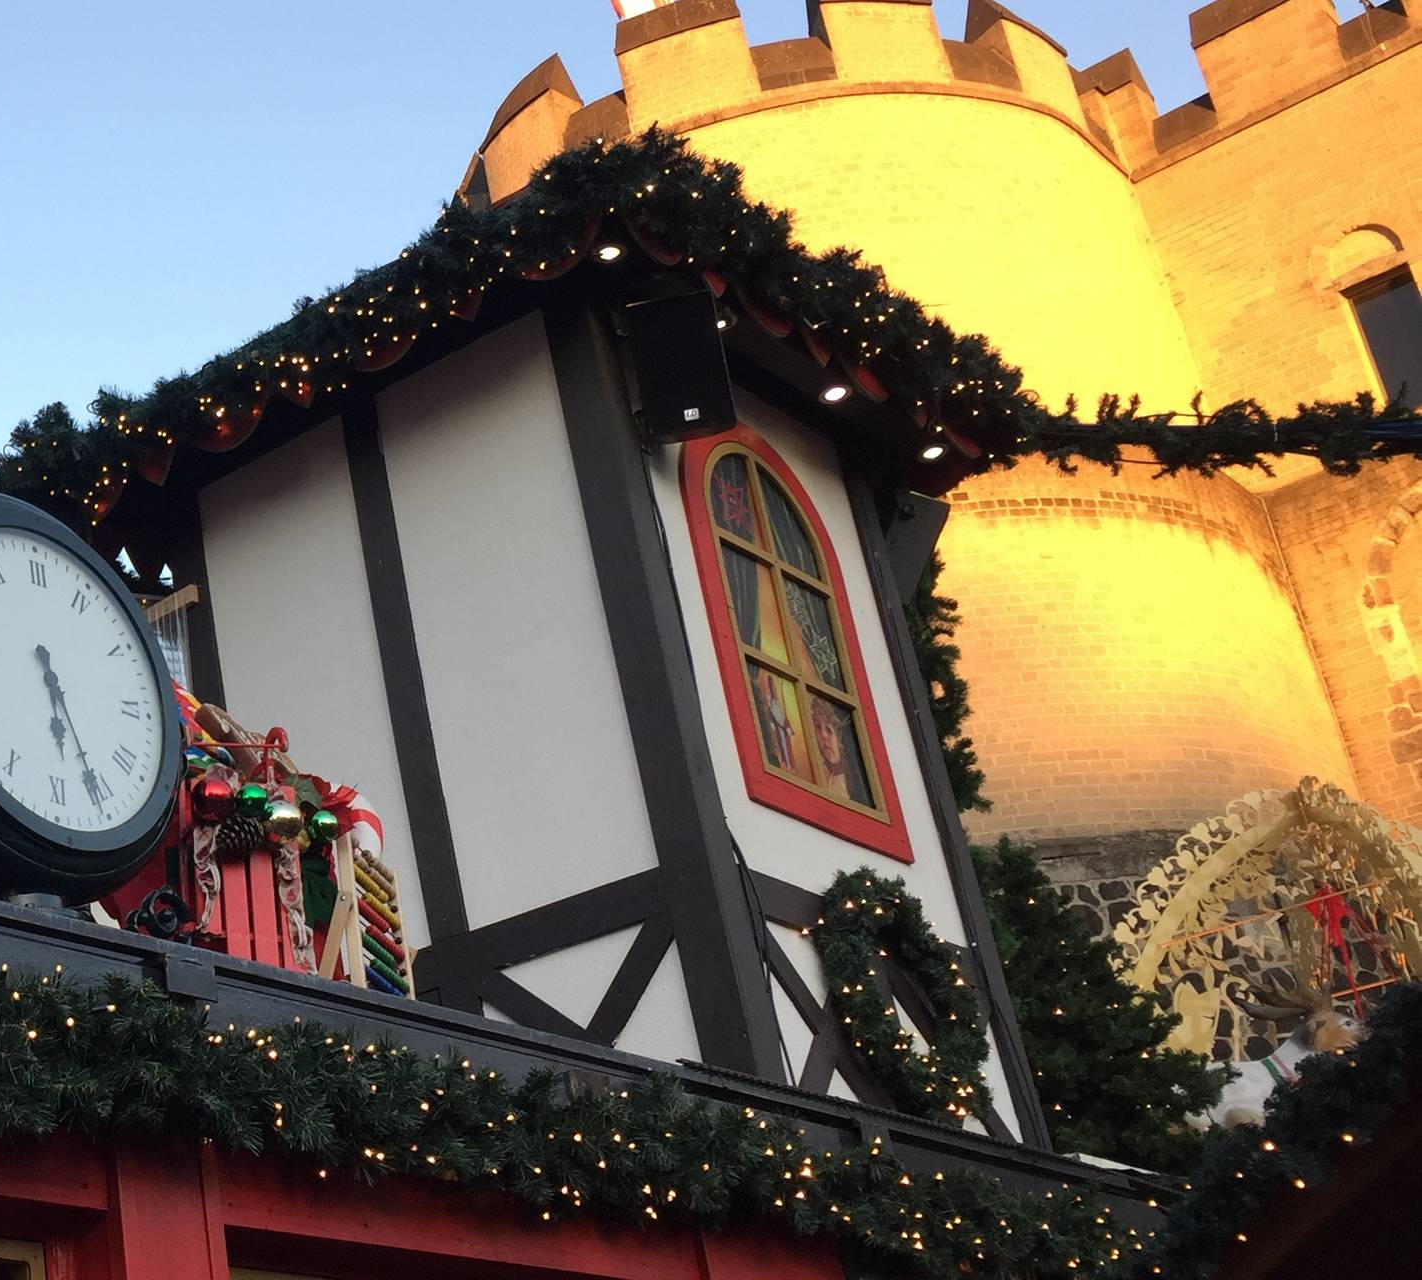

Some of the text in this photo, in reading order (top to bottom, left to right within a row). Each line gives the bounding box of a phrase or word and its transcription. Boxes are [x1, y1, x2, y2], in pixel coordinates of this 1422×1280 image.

[28, 559, 48, 589] III
[71, 590, 91, 615] IV
[2, 748, 22, 777] X
[112, 742, 137, 776] VII
